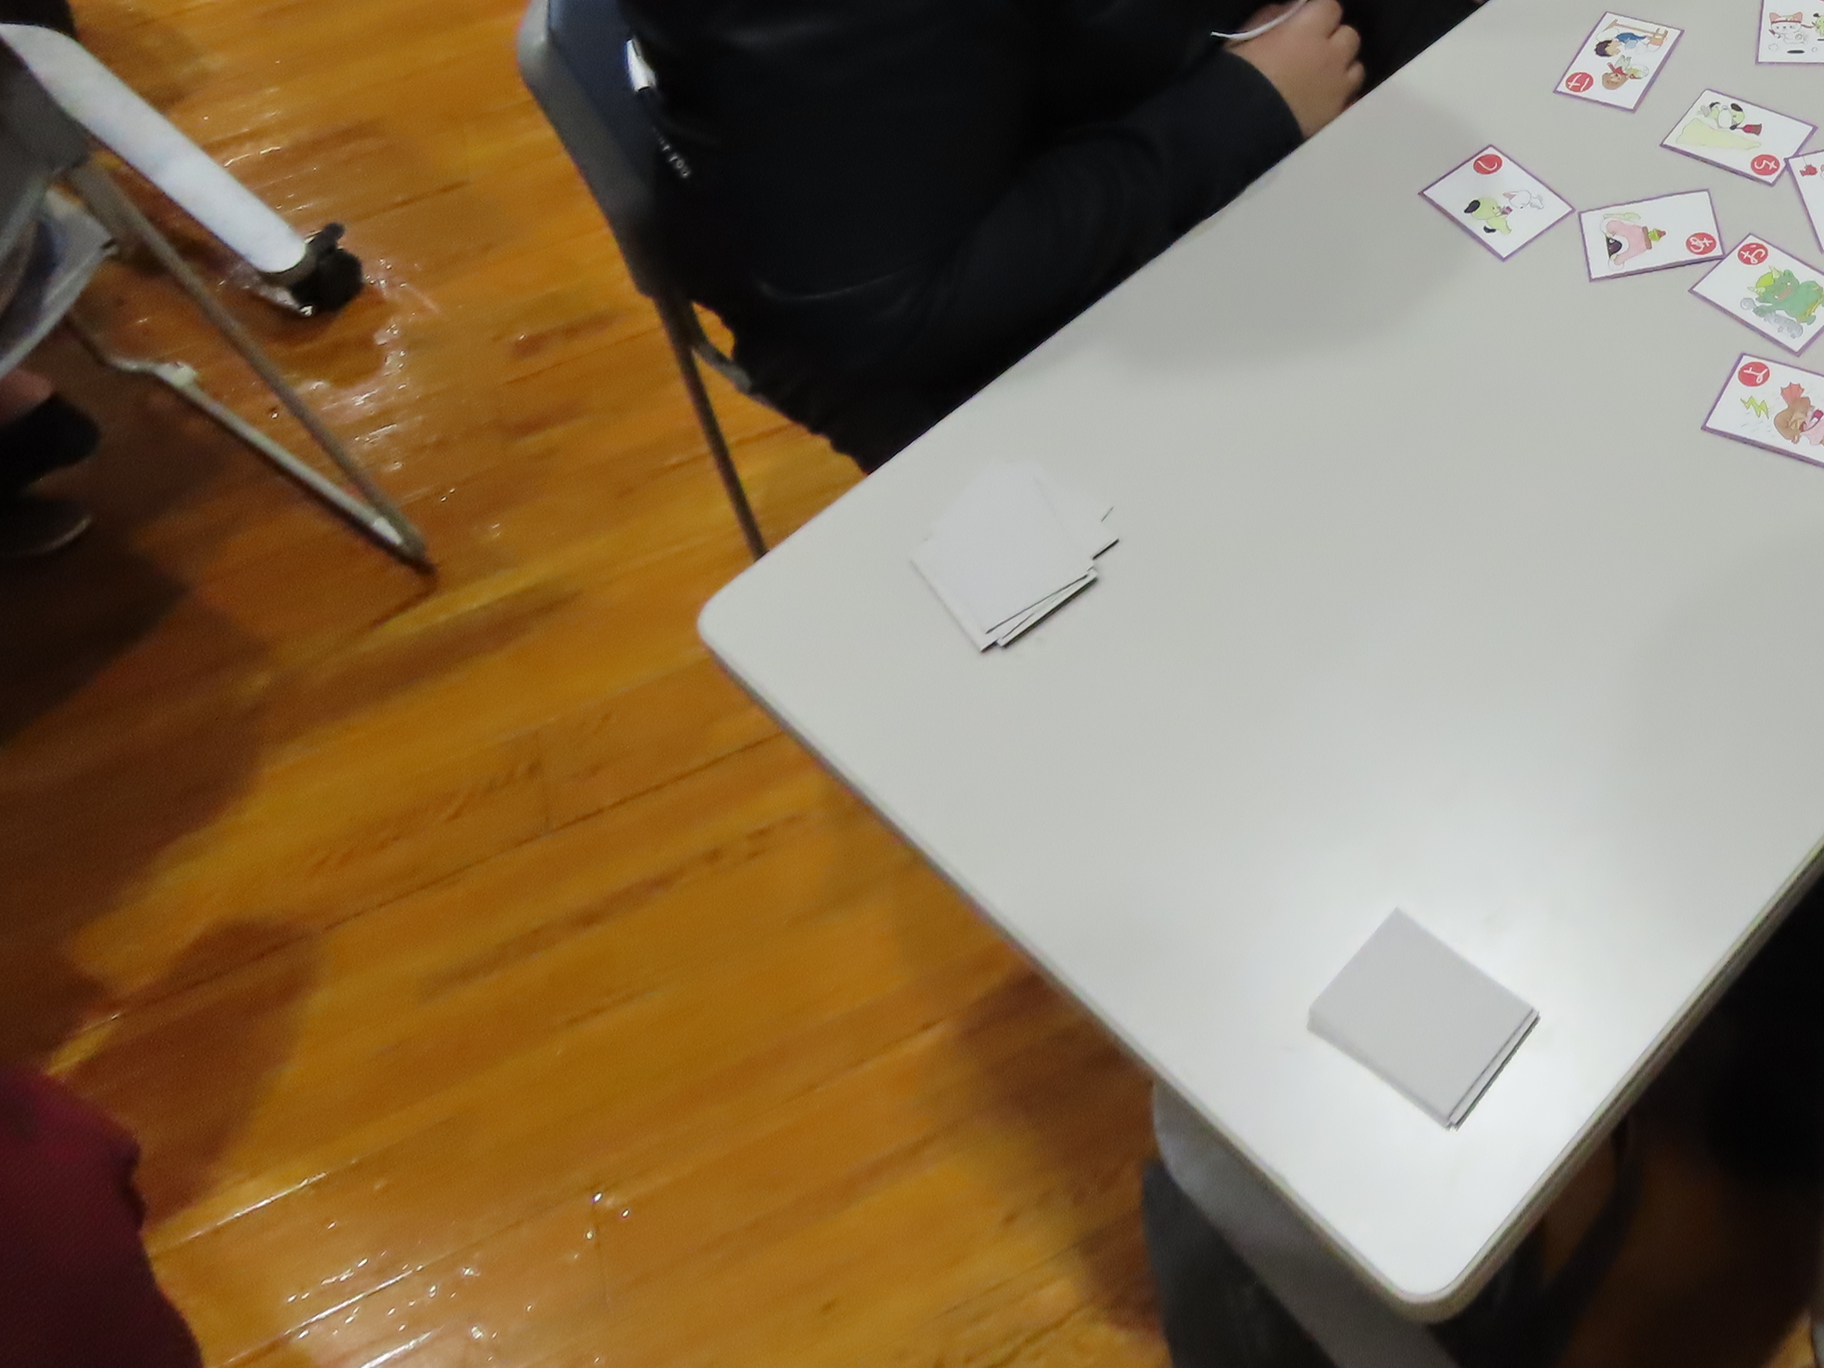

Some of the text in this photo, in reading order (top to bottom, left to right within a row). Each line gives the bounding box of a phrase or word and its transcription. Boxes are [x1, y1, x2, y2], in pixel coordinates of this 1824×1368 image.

[1567, 73, 1591, 92] け
[1687, 235, 1715, 254] あ
[1740, 244, 1767, 264] お
[1742, 366, 1769, 385] よ
